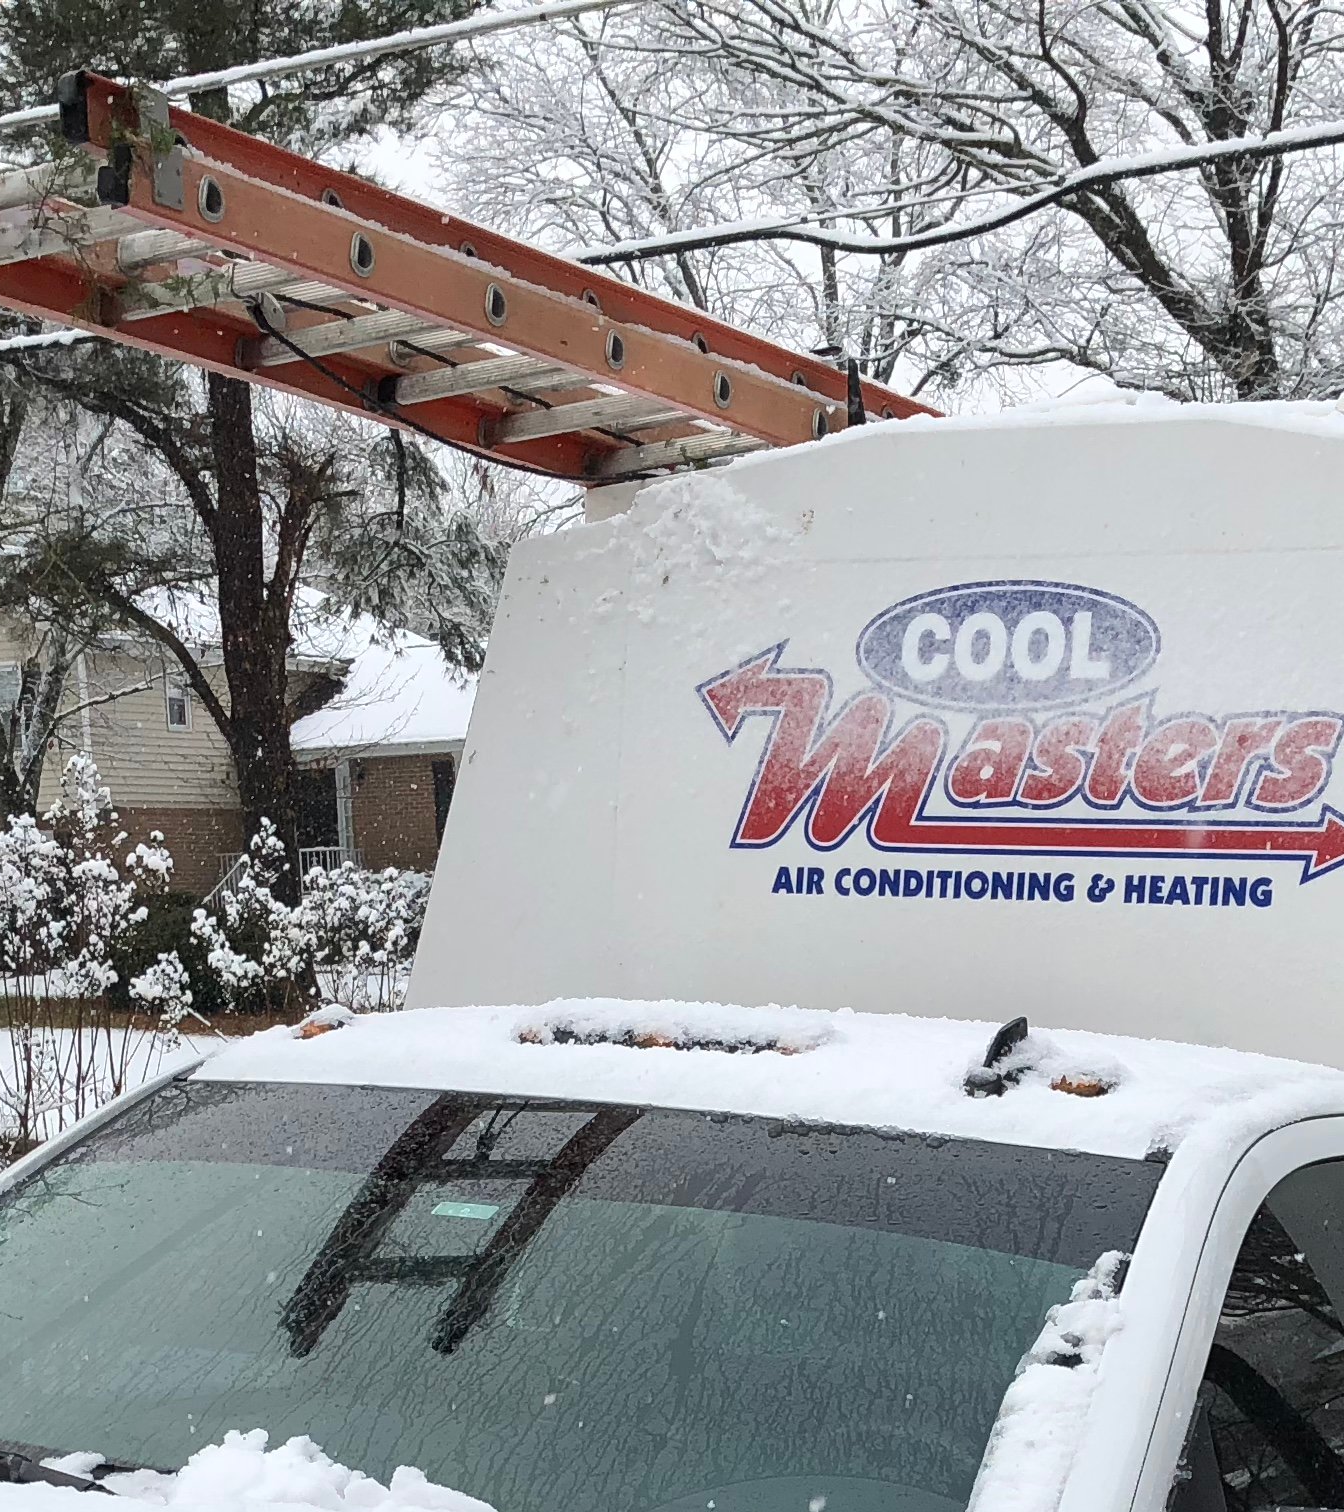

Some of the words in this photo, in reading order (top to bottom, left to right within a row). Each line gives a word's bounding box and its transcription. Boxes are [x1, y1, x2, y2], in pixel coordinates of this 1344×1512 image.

[900, 610, 1111, 682] COOL
[771, 865, 825, 897] AIR
[834, 867, 1075, 903] CONDITIONING
[1086, 873, 1116, 902] &
[1124, 873, 1274, 908] HEATING
